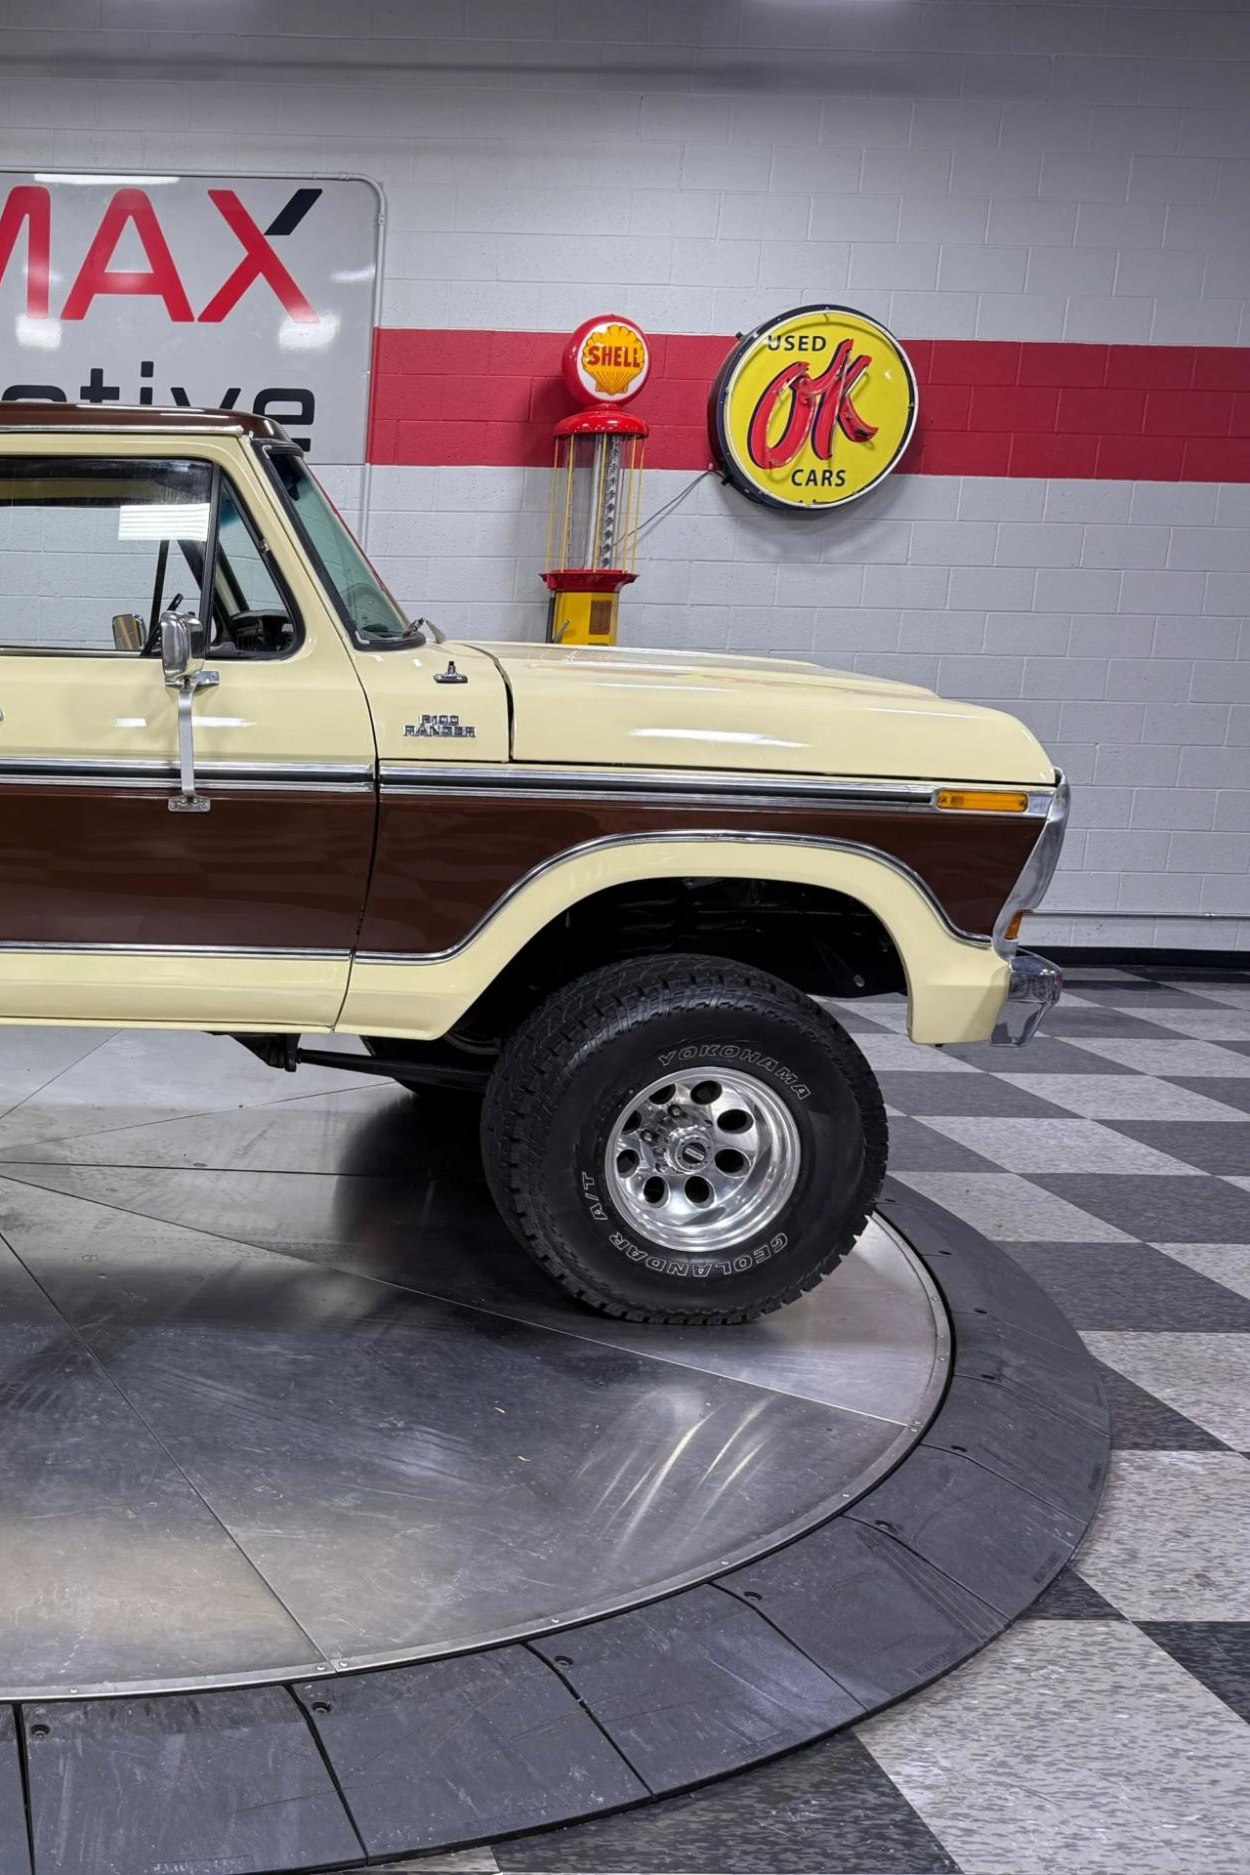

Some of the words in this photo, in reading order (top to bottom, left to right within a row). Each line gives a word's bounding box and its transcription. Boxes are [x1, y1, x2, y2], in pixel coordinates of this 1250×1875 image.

[586, 344, 642, 369] SHELL
[766, 335, 827, 352] USED
[747, 338, 880, 471] OK
[791, 468, 847, 487] CARS
[657, 1043, 813, 1100] YOKOHAMA
[581, 1171, 610, 1222] A/T
[608, 1231, 789, 1278] GEOLANDAR
